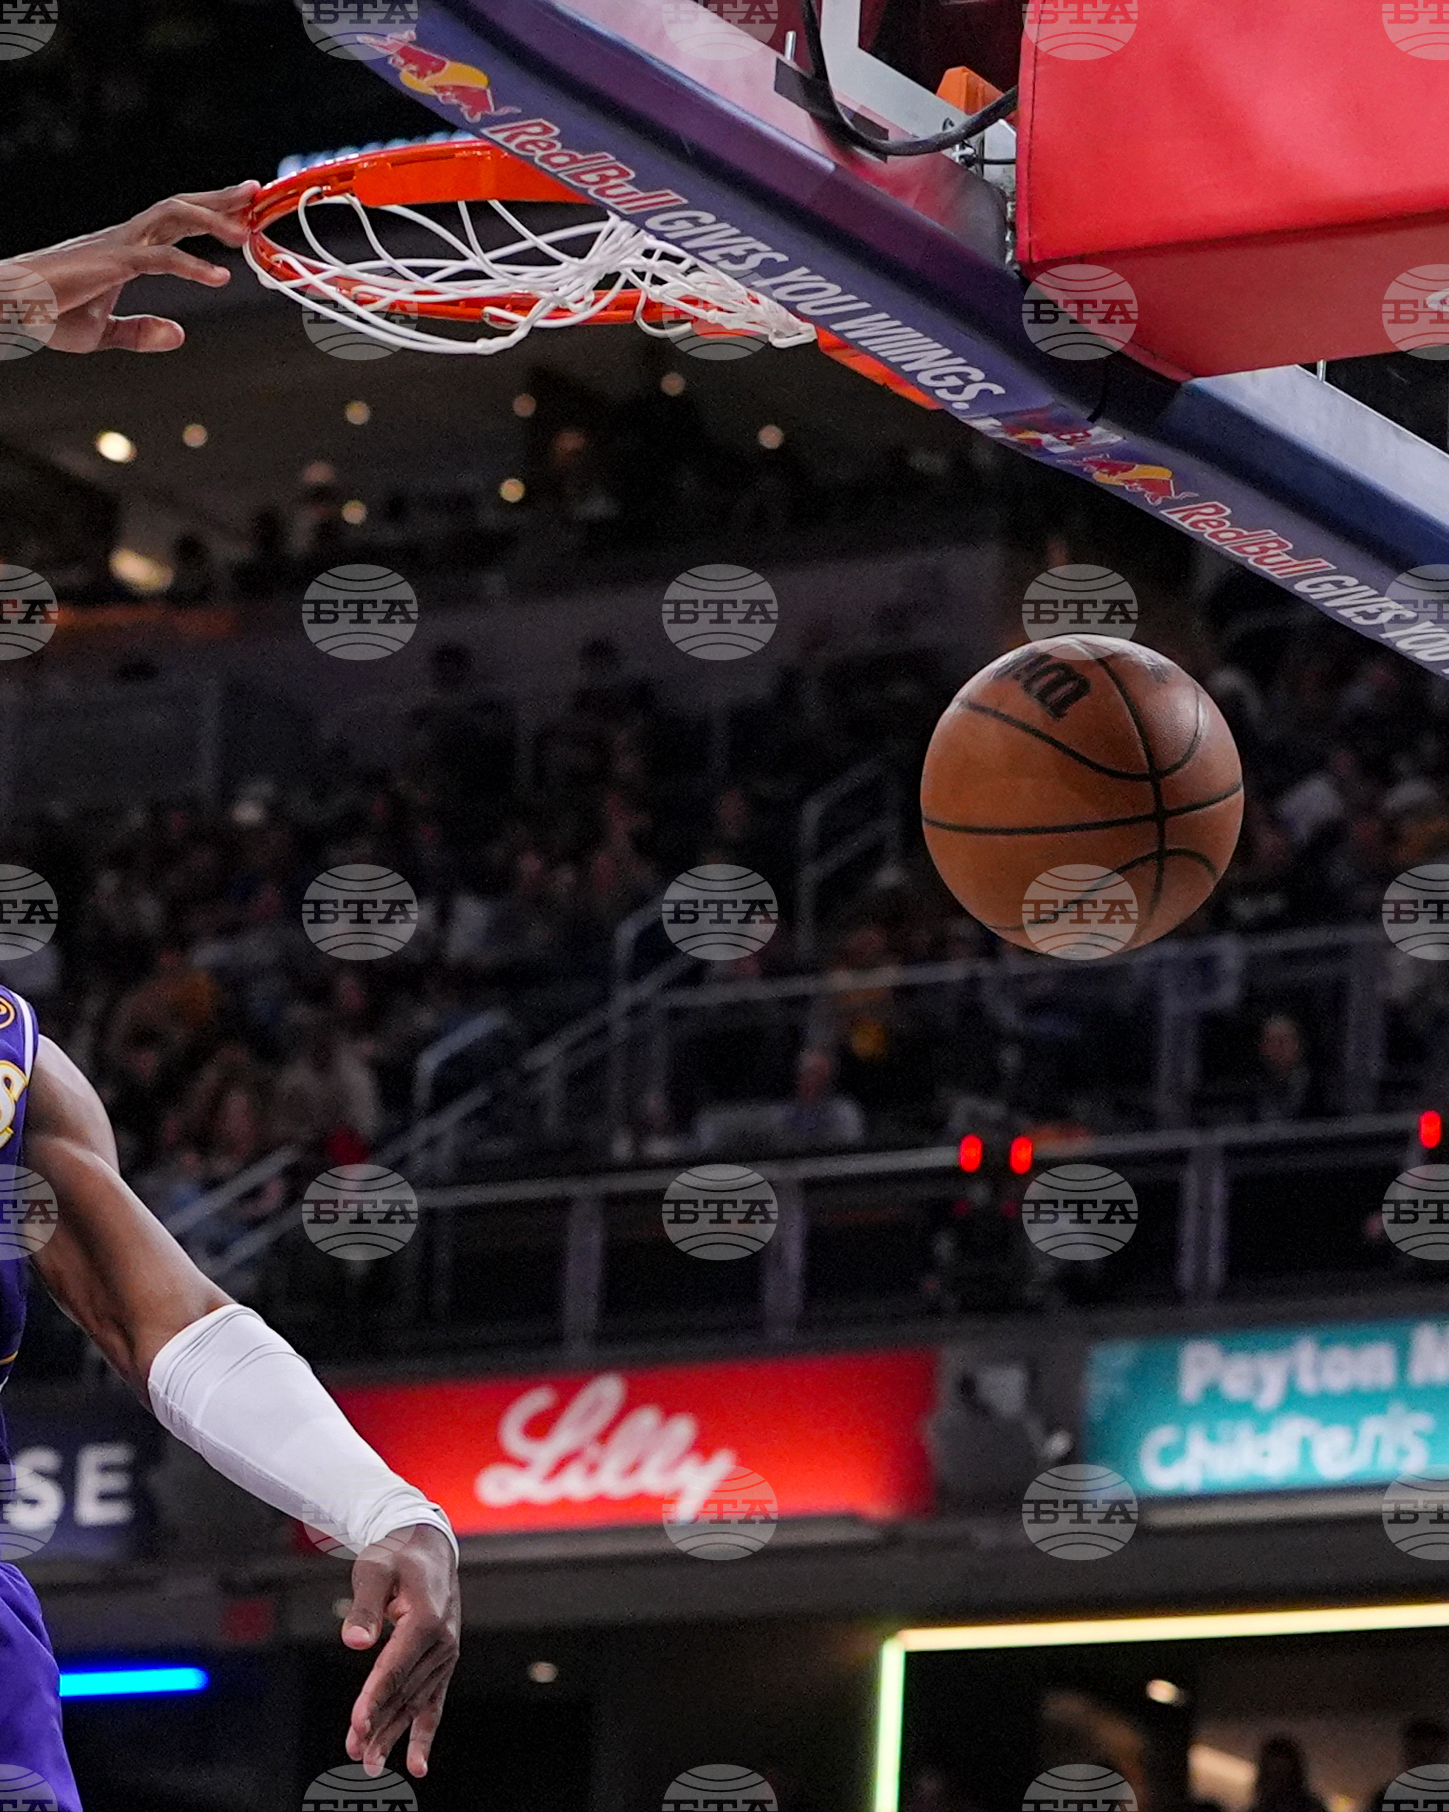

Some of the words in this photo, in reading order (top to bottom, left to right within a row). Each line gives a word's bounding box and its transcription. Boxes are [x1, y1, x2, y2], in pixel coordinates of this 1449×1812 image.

[645, 210, 789, 274] GIVES
[753, 265, 870, 318] YOU
[1293, 575, 1418, 626] GIVES
[1178, 1334, 1396, 1411] Peyton
[473, 1372, 737, 1524] Lilly
